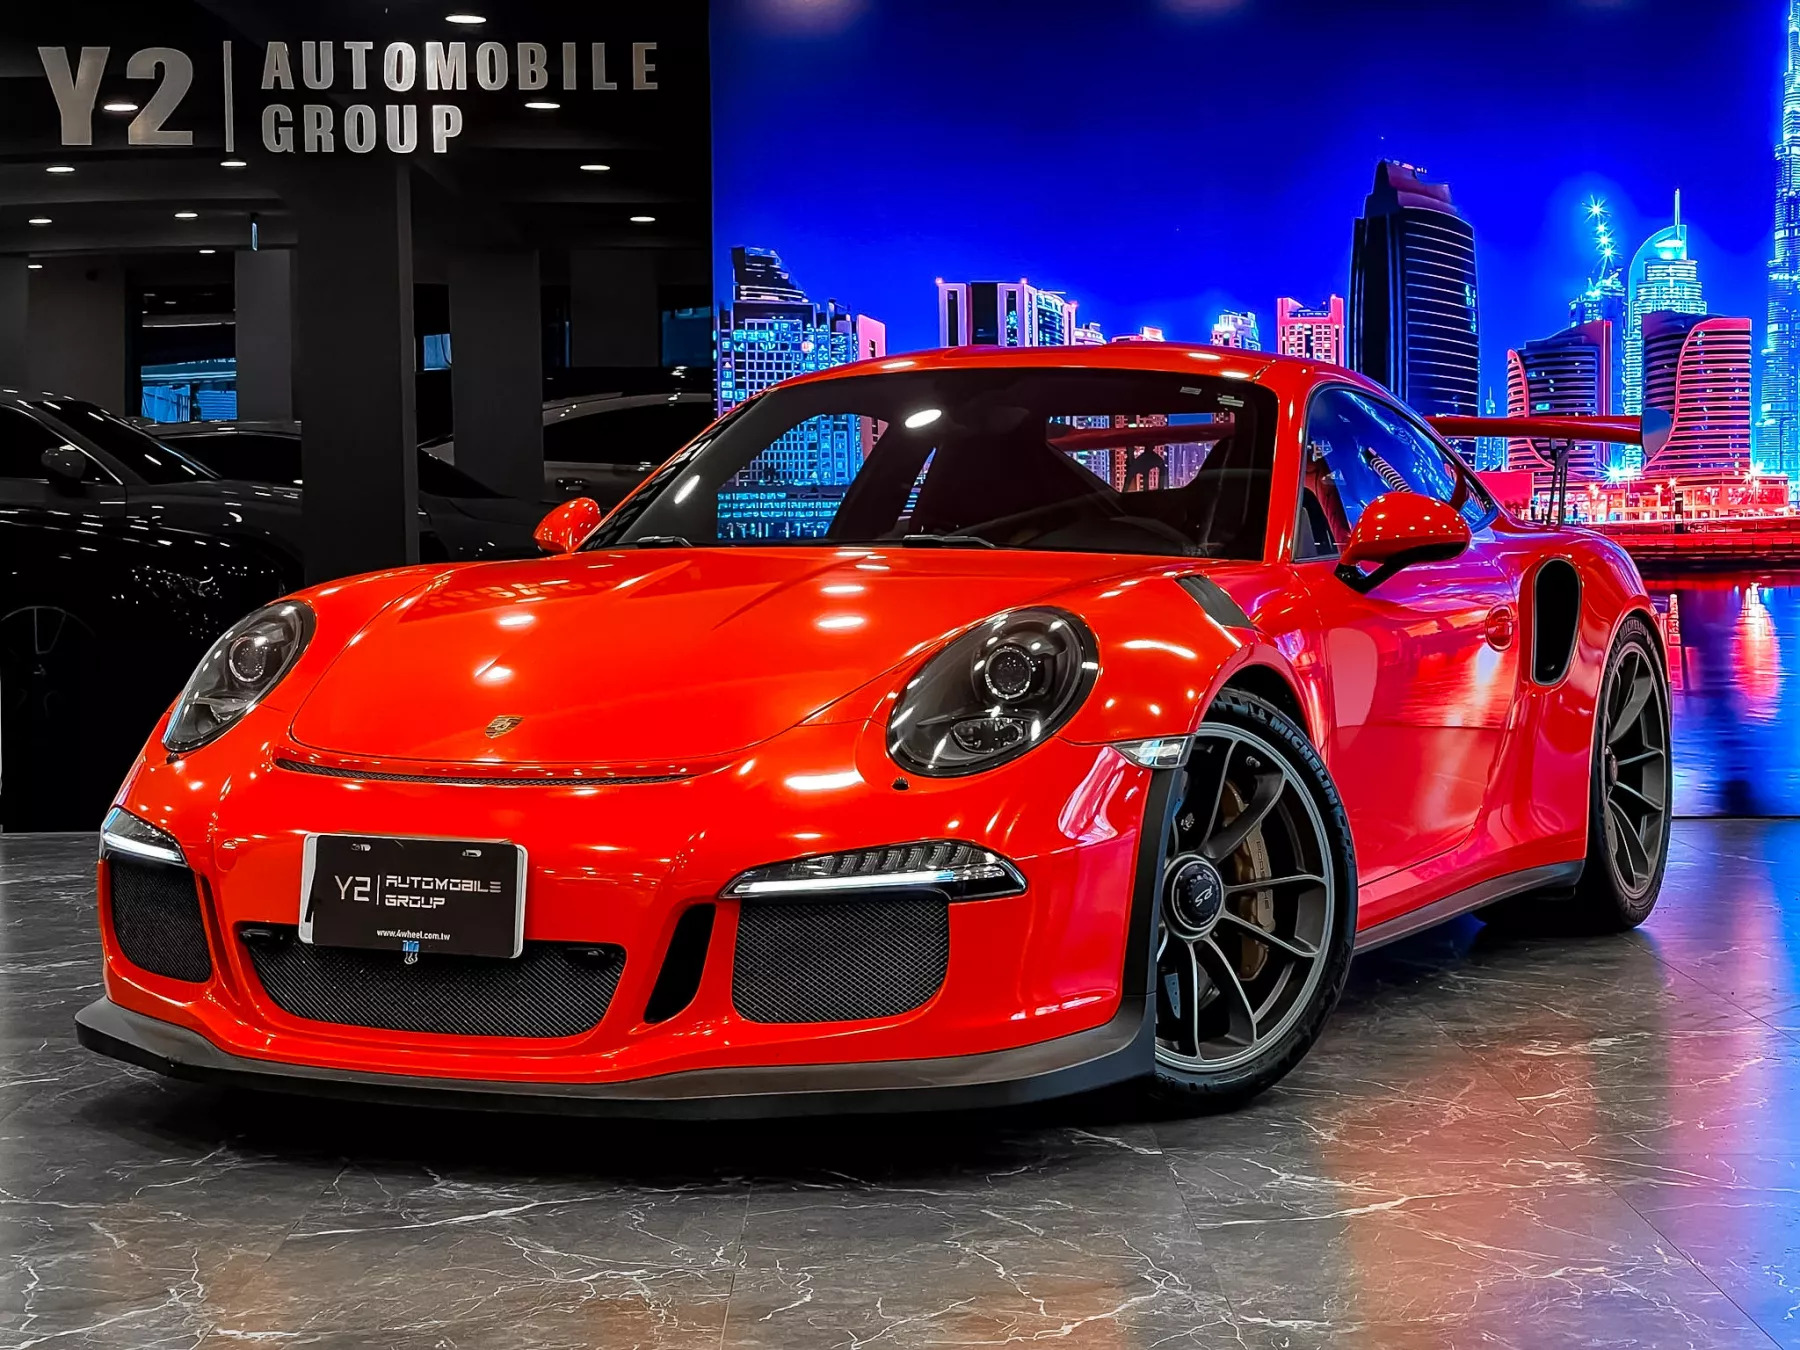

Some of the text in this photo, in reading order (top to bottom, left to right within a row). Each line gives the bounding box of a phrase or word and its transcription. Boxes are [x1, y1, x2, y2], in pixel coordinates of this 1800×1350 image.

[261, 41, 658, 91] AUTOMOBILE
[37, 46, 194, 146] Y2
[261, 104, 463, 154] GROUP
[1269, 717, 1338, 805] MICHELIN
[335, 875, 371, 902] Y2
[385, 875, 502, 893] AUTOMOBILE
[385, 894, 446, 909] GROUP
[376, 929, 451, 941] www.4wheel.com.tw
